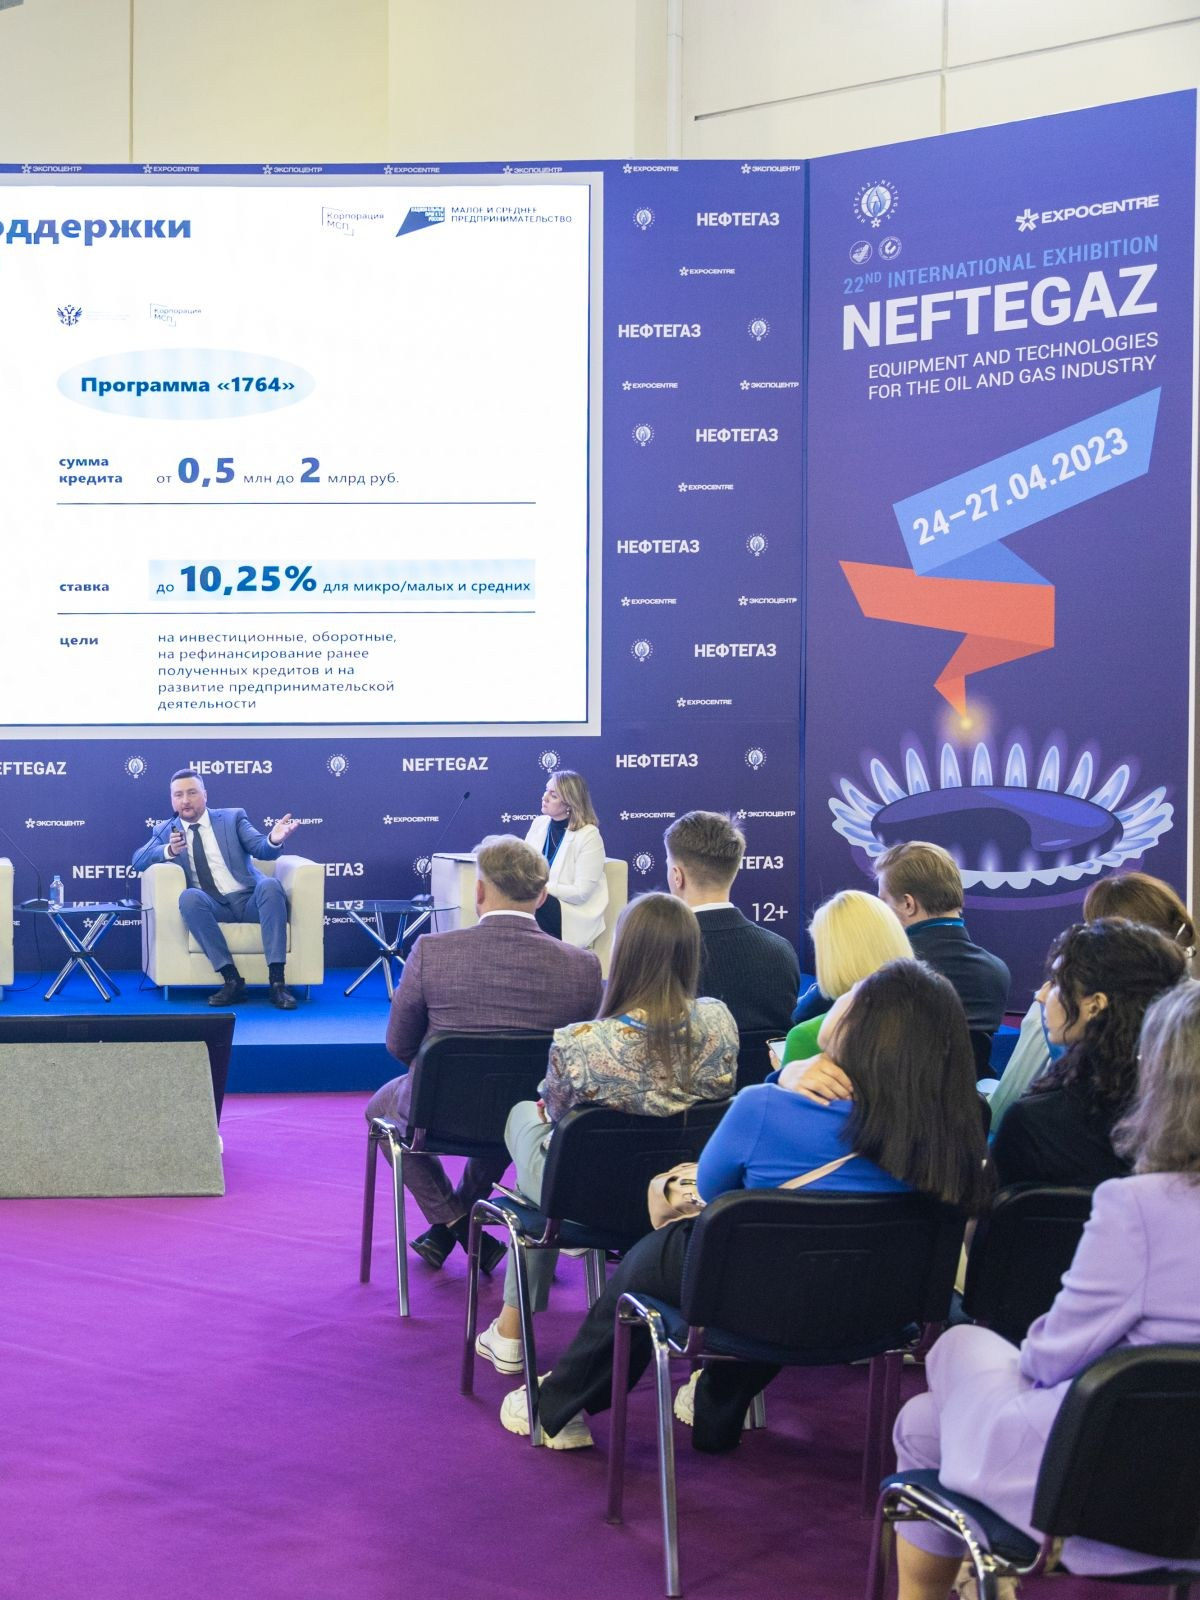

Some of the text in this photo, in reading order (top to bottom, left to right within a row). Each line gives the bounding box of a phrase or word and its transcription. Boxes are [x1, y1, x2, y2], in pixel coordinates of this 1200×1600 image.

[274, 166, 323, 174] ЭКСПОЦЕНТР
[752, 165, 801, 173] ЭКСПОЦЕНТР
[1041, 194, 1159, 224] EXPOCENTRE
[326, 212, 385, 223] Корпорация
[451, 215, 573, 224] ПРЕДПРИНИМАТЕЛЬСТВО
[696, 211, 780, 227] НЕФТЕГАЗ
[888, 253, 1036, 288] INTERNATIONAL
[1043, 234, 1158, 267] EXHIBITION
[843, 263, 1158, 350] NEFTEGAZ
[618, 323, 702, 339] НЕФТЕГАЗ
[869, 331, 1159, 379] EQUIPMENT AND TECHNOLOGIES
[869, 354, 1157, 400] FOR THE OIL AND GAS INDUSTRY
[81, 376, 296, 398] Программа «1764»
[751, 381, 800, 389] ЭКСПОЦЕНТР
[695, 427, 779, 443] НЕФТЕГАЗ
[58, 458, 110, 470] сумма
[156, 456, 399, 488] от 0,5 млн до 2 млрд руб.
[59, 475, 123, 487] кредита
[617, 539, 700, 554] НЕФТЕГАЗ
[59, 583, 110, 592] ставка
[156, 565, 531, 596] до 10,25% для микро/малых и средних
[749, 597, 798, 605] ЭКСПОЦЕНТР
[59, 637, 99, 648] цели
[158, 630, 397, 645] на инвестиционные, оборотные,
[158, 648, 369, 662] на рефинансирование ранее
[694, 643, 777, 658] НЕФТЕГАЗ
[158, 666, 355, 679] полученных кредитов и на
[158, 683, 395, 696] развитие предпринимательской
[157, 700, 256, 712] деятельности
[189, 760, 273, 775] НЕФТЕГАЗ
[402, 756, 489, 772] NEFTEGAZ
[615, 753, 699, 768] НЕФТЕГАЗ
[748, 810, 796, 818] ЭКСПОЦЕНТР
[739, 855, 784, 870] ТЕГАЗ
[72, 865, 142, 879] NEFTEG
[751, 902, 789, 925] 12+
